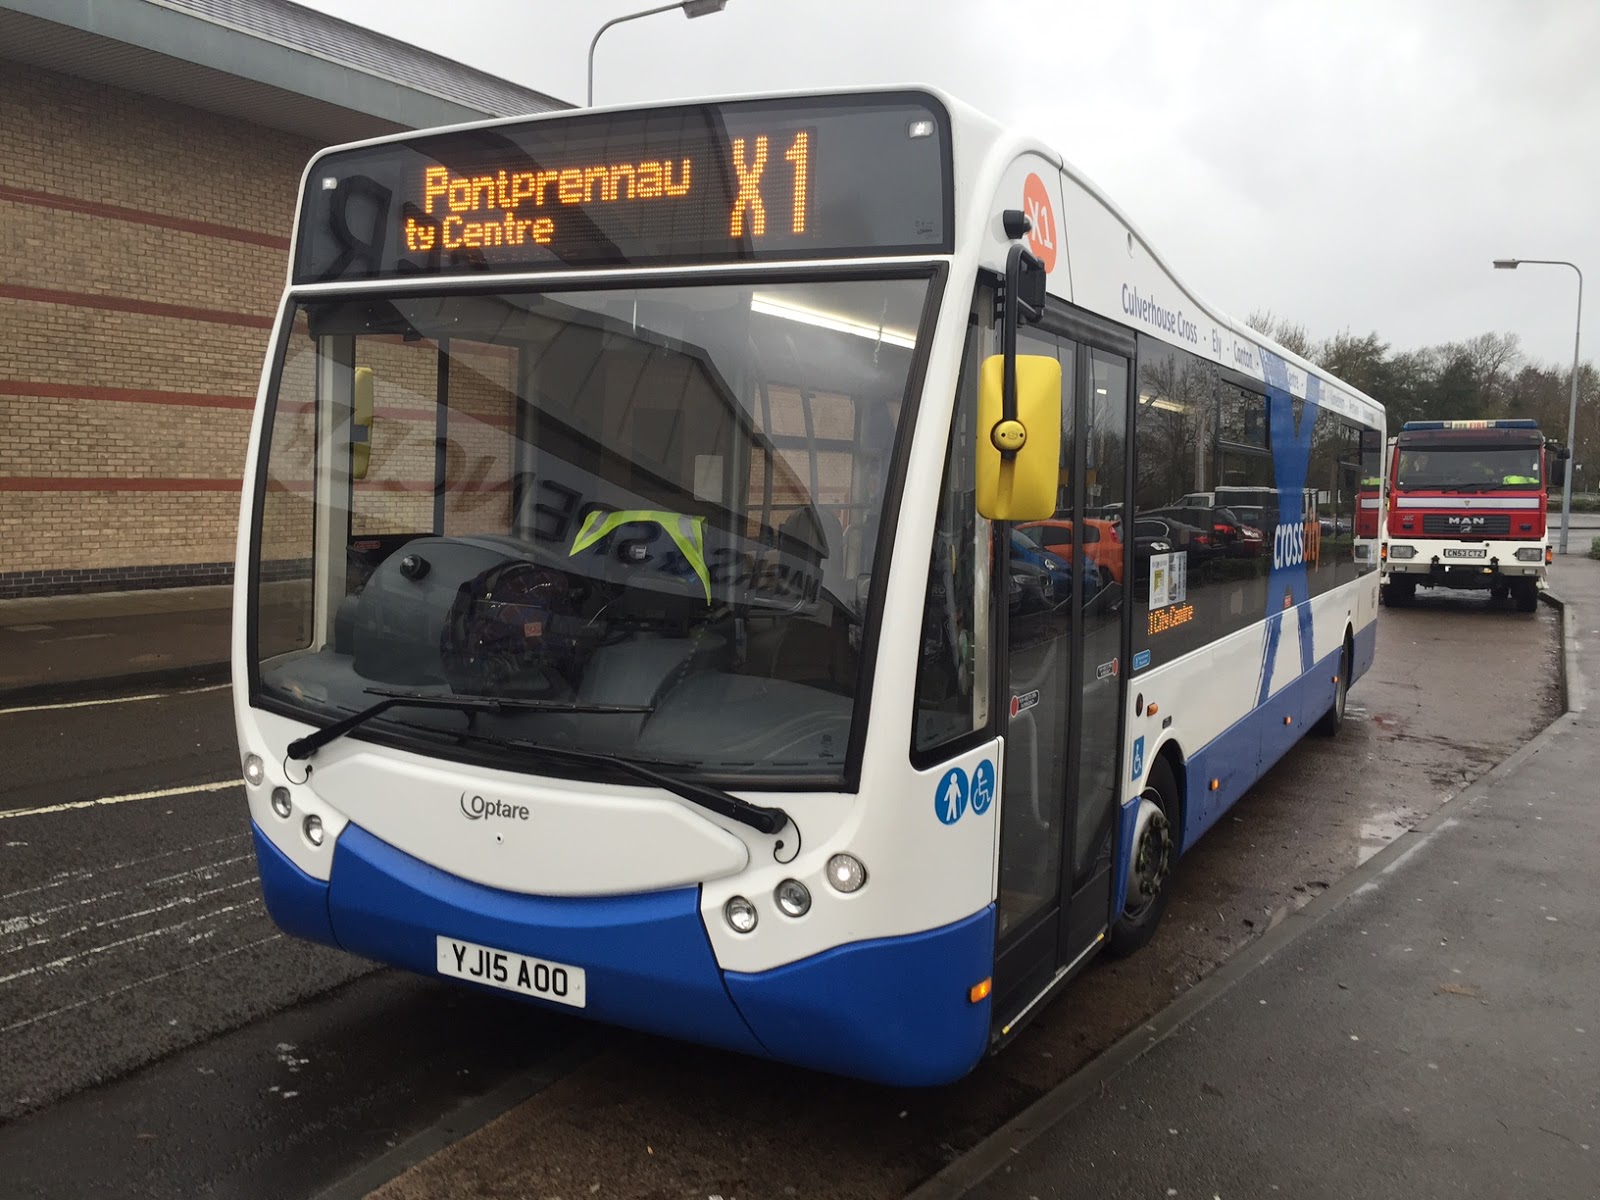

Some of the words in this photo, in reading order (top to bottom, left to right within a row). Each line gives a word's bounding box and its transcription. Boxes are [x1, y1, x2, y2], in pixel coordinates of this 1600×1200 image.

[424, 157, 691, 214] Pontprennau
[404, 218, 435, 252] ty
[442, 211, 555, 249] Centre
[1027, 196, 1054, 250] X1
[1121, 282, 1176, 334] Culverhouse
[1177, 311, 1198, 345] Cross
[1212, 328, 1222, 360] Ely
[1448, 517, 1485, 525] MAN
[468, 793, 530, 821] Optare
[452, 942, 509, 984] YJ15
